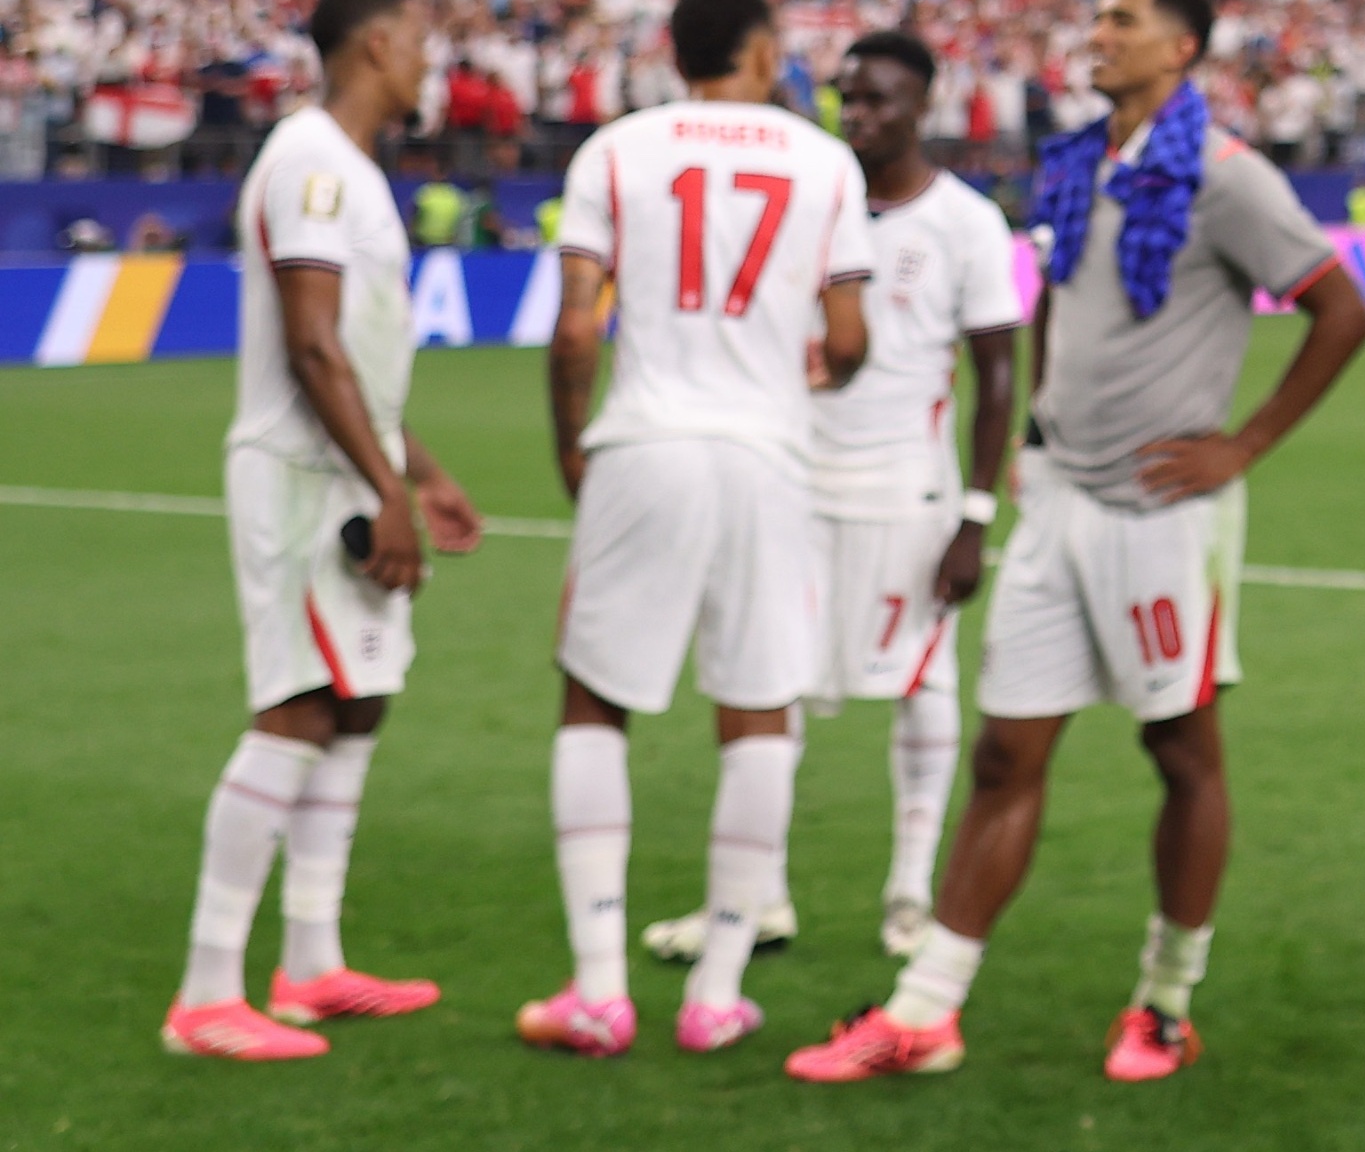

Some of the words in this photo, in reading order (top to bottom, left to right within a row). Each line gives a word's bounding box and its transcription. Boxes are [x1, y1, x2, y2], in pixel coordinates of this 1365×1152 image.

[671, 120, 790, 152] ROGERS
[671, 165, 794, 317] 17
[881, 595, 907, 651] 7
[1131, 597, 1184, 665] 10
